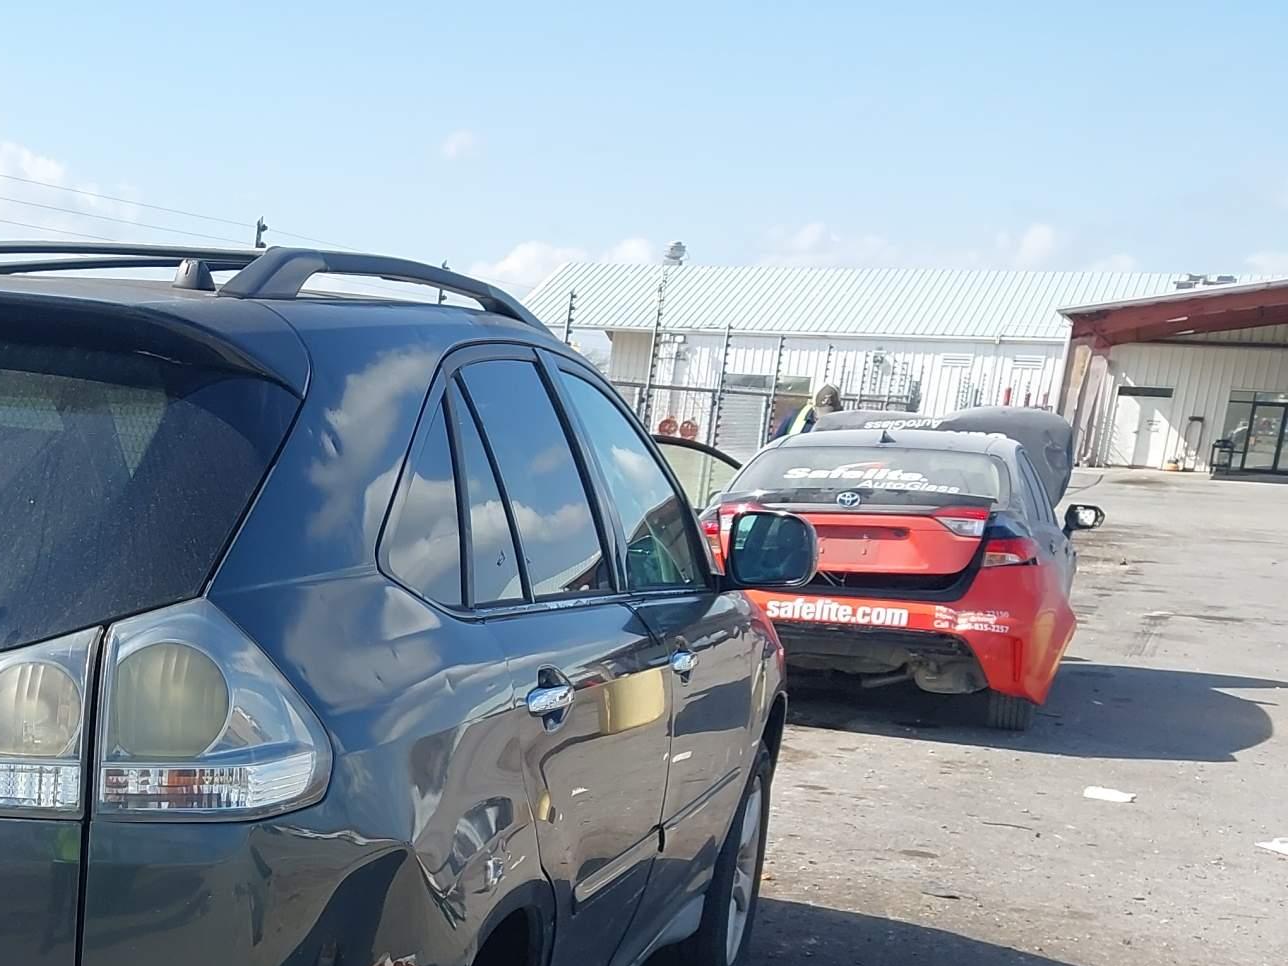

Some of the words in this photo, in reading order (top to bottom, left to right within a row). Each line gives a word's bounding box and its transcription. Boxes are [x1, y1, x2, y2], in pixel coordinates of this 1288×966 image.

[863, 419, 944, 430] AutoGlass
[856, 480, 960, 493] AutoGlass
[766, 598, 908, 626] safelite.com
